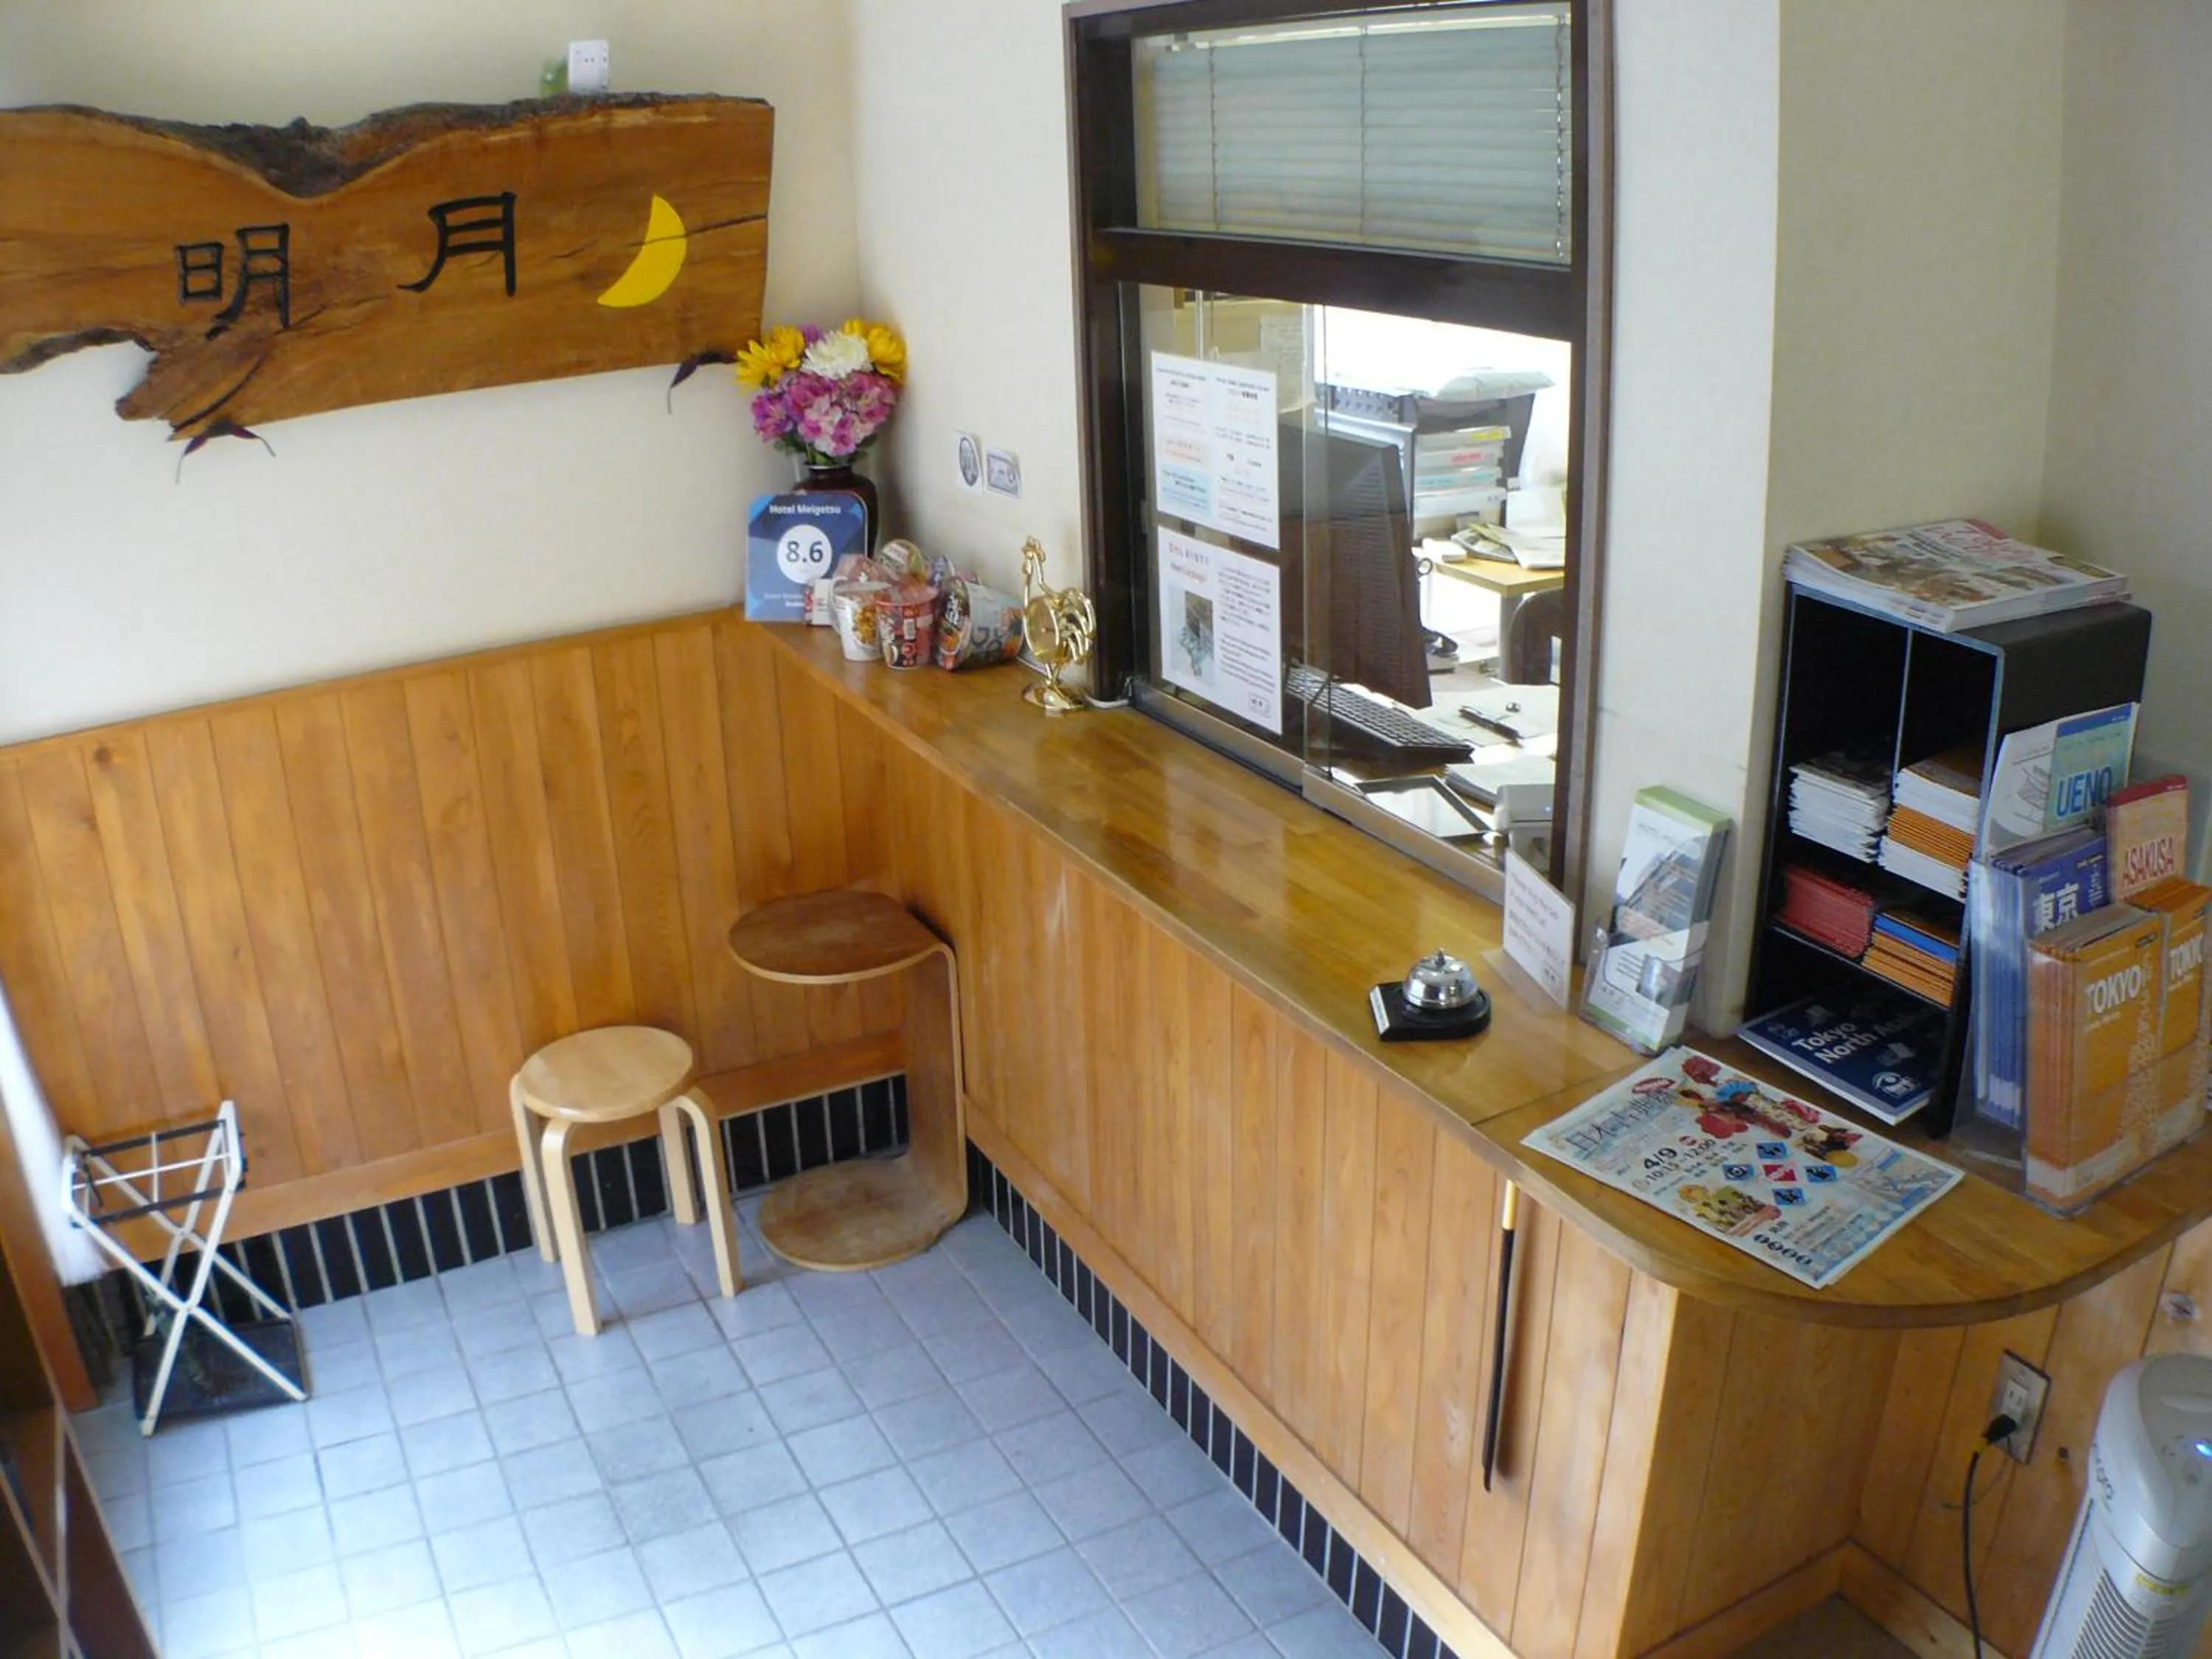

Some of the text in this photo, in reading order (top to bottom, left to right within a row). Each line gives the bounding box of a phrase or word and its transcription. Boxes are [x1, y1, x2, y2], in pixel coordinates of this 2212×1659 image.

[769, 504, 841, 516] Hotel Meigetsu
[786, 540, 824, 563] 8.6
[2056, 766, 2112, 817] UENO
[2122, 837, 2175, 886] ASAKUSA
[2032, 883, 2080, 936] 東京
[2084, 964, 2141, 1017] TOKYO
[1791, 1023, 1858, 1051] Tokyo
[1813, 1032, 1877, 1064] North
[1644, 1147, 1678, 1171] 4/9
